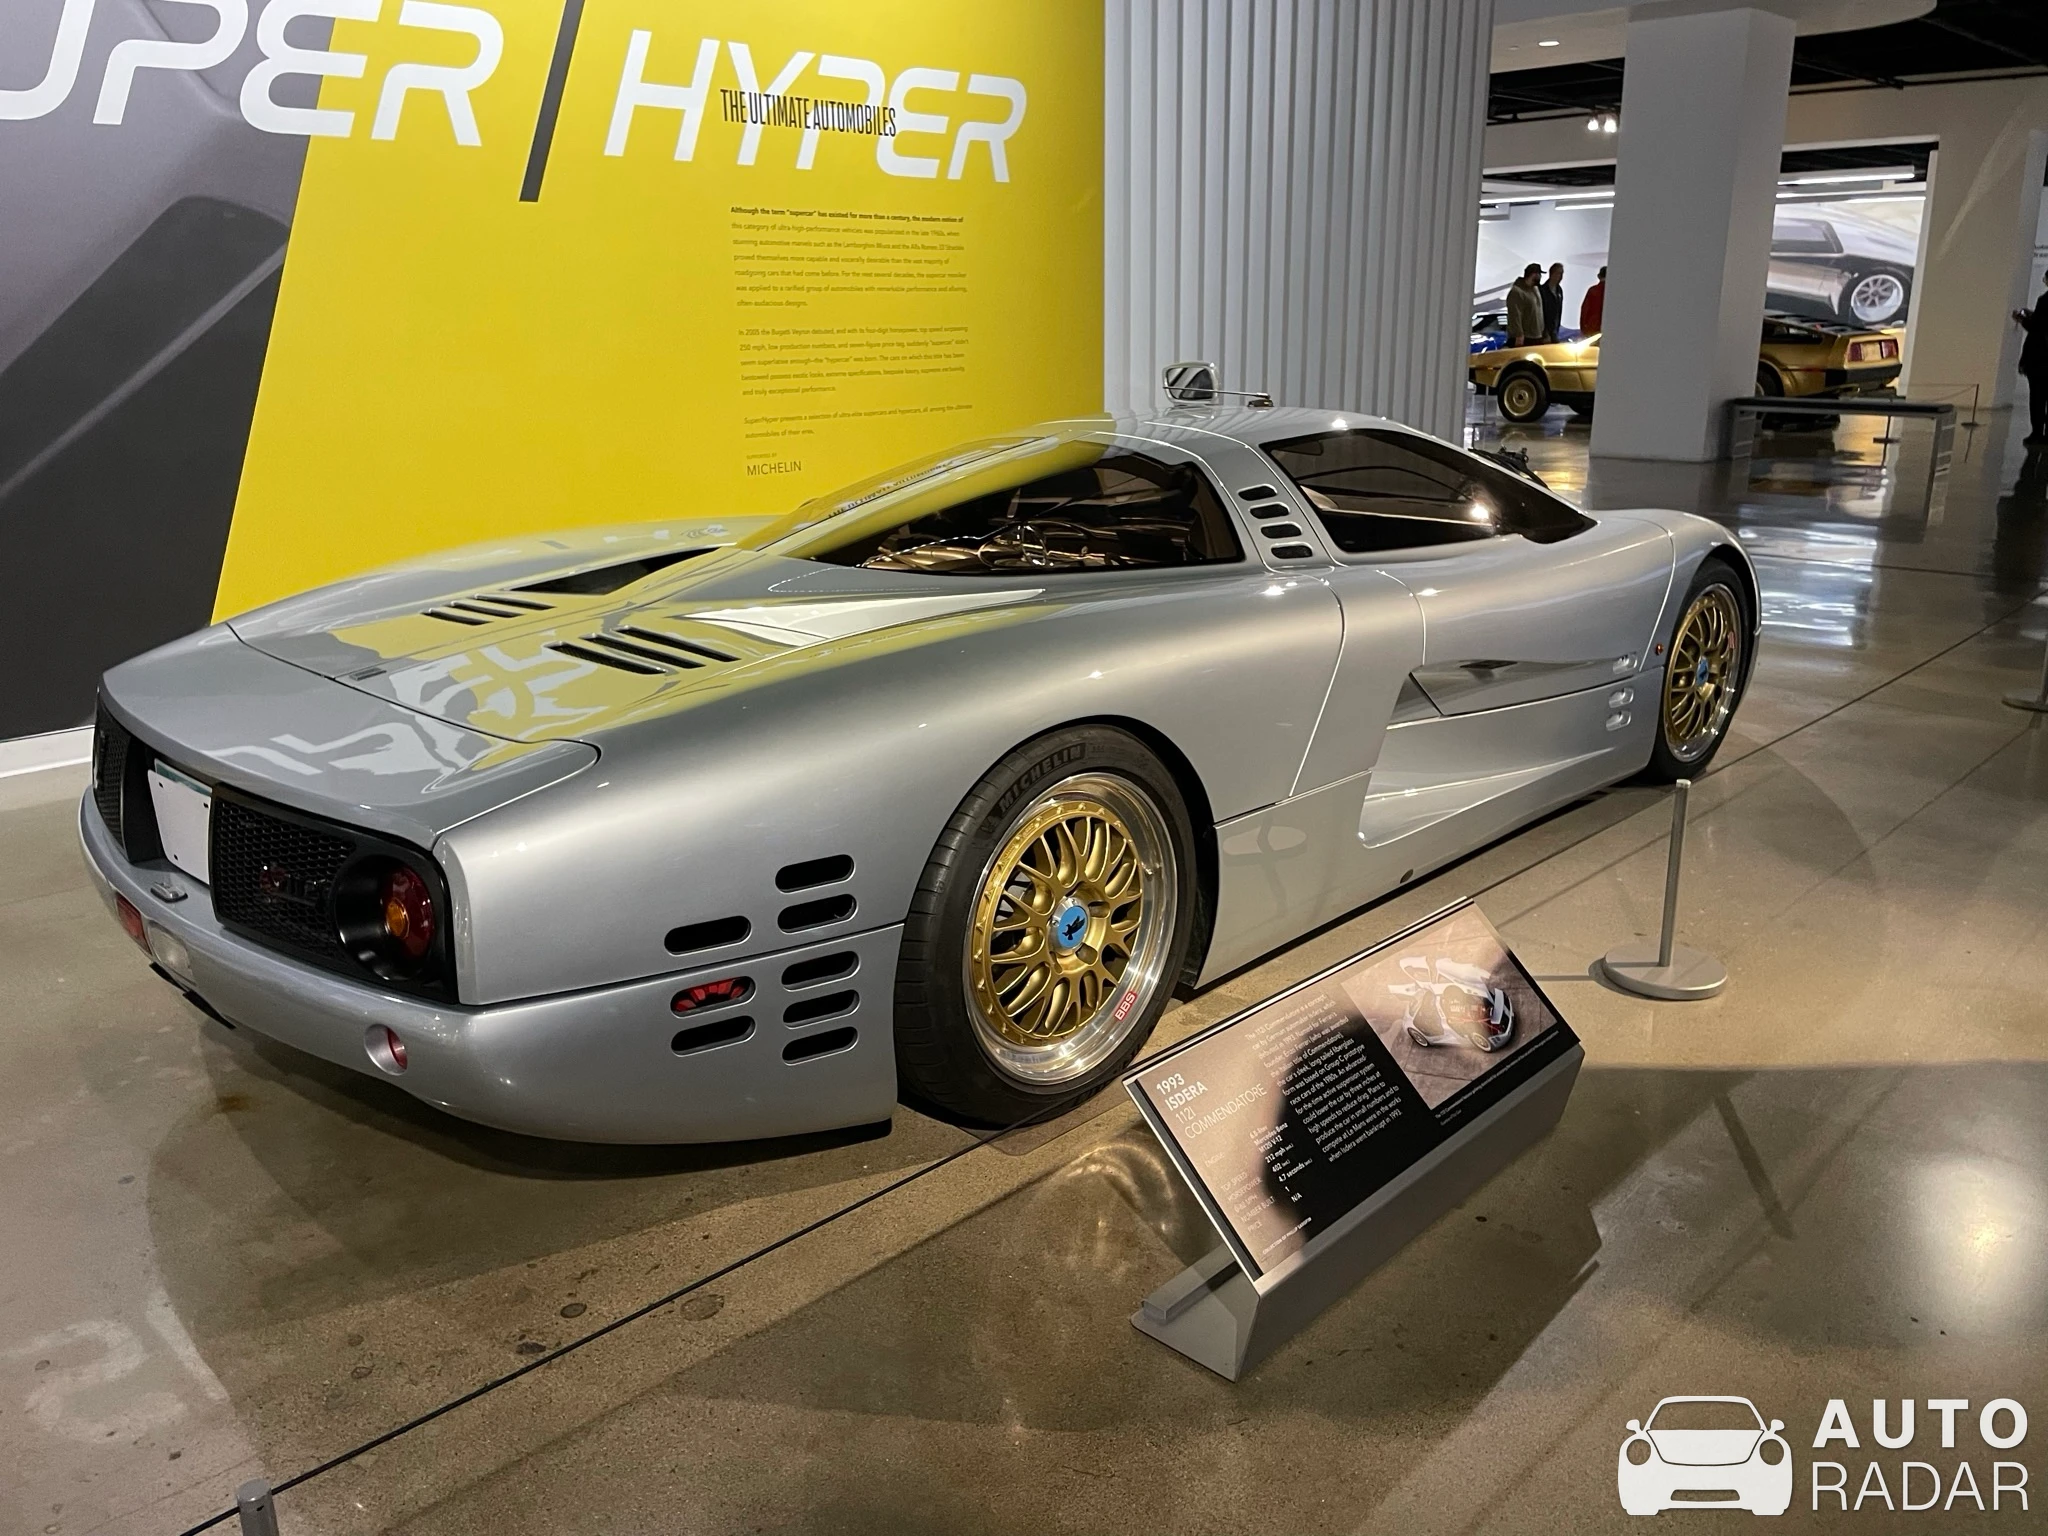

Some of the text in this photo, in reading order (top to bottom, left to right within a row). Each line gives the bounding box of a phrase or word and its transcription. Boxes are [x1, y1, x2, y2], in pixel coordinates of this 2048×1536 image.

[604, 29, 1027, 183] HYPER
[720, 89, 897, 137] THE ULTIMATE AUTOMOBILES
[747, 461, 802, 476] MICHELIN
[999, 745, 1083, 813] MICHELIN
[1115, 992, 1136, 1020] BBS
[1311, 1020, 1320, 1028] for
[1321, 1027, 1330, 1035] was
[1328, 1015, 1349, 1030] awarded
[1275, 1077, 1285, 1086] the
[1332, 1037, 1355, 1054] fiberglass
[1281, 1084, 1295, 1095] form
[1294, 1080, 1304, 1089] was
[1302, 1070, 1319, 1083] based
[1323, 1058, 1340, 1071] Group
[1342, 1042, 1365, 1060] prototype
[1155, 1073, 1185, 1095] 1993
[1165, 1080, 1207, 1110] ISDERA
[1289, 1095, 1301, 1105] race
[1300, 1089, 1311, 1098] cars
[1314, 1080, 1324, 1089] the
[1321, 1085, 1336, 1097] active
[1334, 1070, 1361, 1090] suspension
[1358, 1061, 1375, 1075] system
[1183, 1083, 1266, 1138] COMMENDATORE
[1301, 1111, 1316, 1123] could
[1314, 1103, 1329, 1115] lower
[1327, 1098, 1337, 1107] the
[1336, 1094, 1345, 1102] car
[1349, 1082, 1362, 1093] three
[1360, 1073, 1376, 1086] inches
[1307, 1122, 1321, 1134] high
[1318, 1111, 1338, 1127] speeds
[1340, 1098, 1357, 1112] reduce
[1367, 1083, 1380, 1094] Plans
[1314, 1126, 1336, 1144] produce
[1333, 1120, 1343, 1130] the
[1353, 1105, 1367, 1116] small
[1365, 1093, 1385, 1109] numbers
[1383, 1087, 1394, 1096] and
[1320, 1134, 1344, 1153] compete
[1352, 1119, 1365, 1131] Mans
[1364, 1113, 1377, 1123] were
[1379, 1103, 1389, 1113] the
[1387, 1095, 1401, 1107] works
[1258, 1141, 1272, 1152] M120
[1265, 1153, 1275, 1162] 212
[1273, 1146, 1286, 1158] mph
[1327, 1149, 1342, 1161] when
[1339, 1139, 1356, 1153] Isdera
[1354, 1132, 1367, 1143] went
[1365, 1119, 1387, 1137] bankrupt
[1271, 1163, 1281, 1172] 402
[1277, 1173, 1287, 1182] 4.7
[1285, 1161, 1304, 1177] seconds
[1291, 1192, 1302, 1202] N/A
